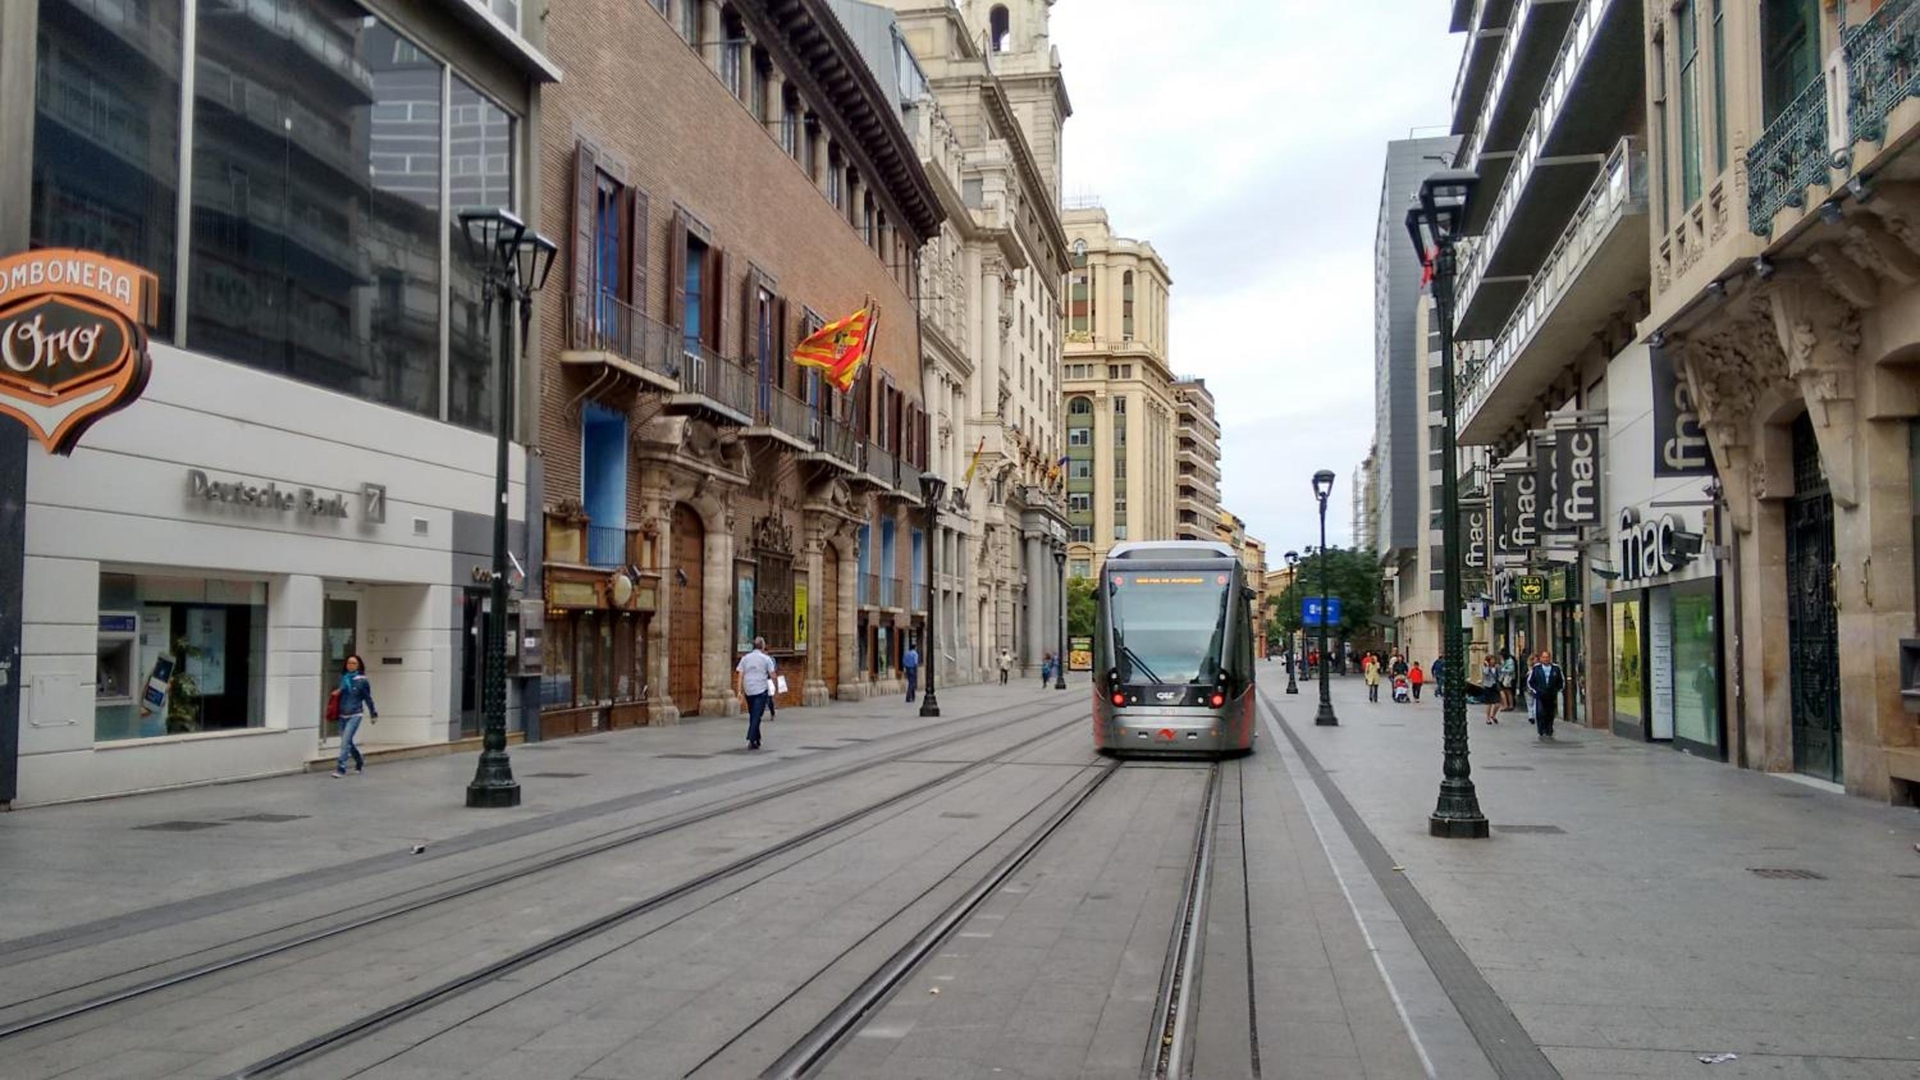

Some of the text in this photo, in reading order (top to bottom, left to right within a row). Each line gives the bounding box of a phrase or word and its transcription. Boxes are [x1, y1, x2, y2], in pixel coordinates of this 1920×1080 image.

[2, 314, 101, 372] Oro
[188, 469, 348, 519] Deutsche Bank
[1563, 432, 1595, 522] fnac
[1465, 512, 1484, 568] fnac
[1512, 475, 1536, 547] fnac
[1618, 507, 1682, 581] fnac
